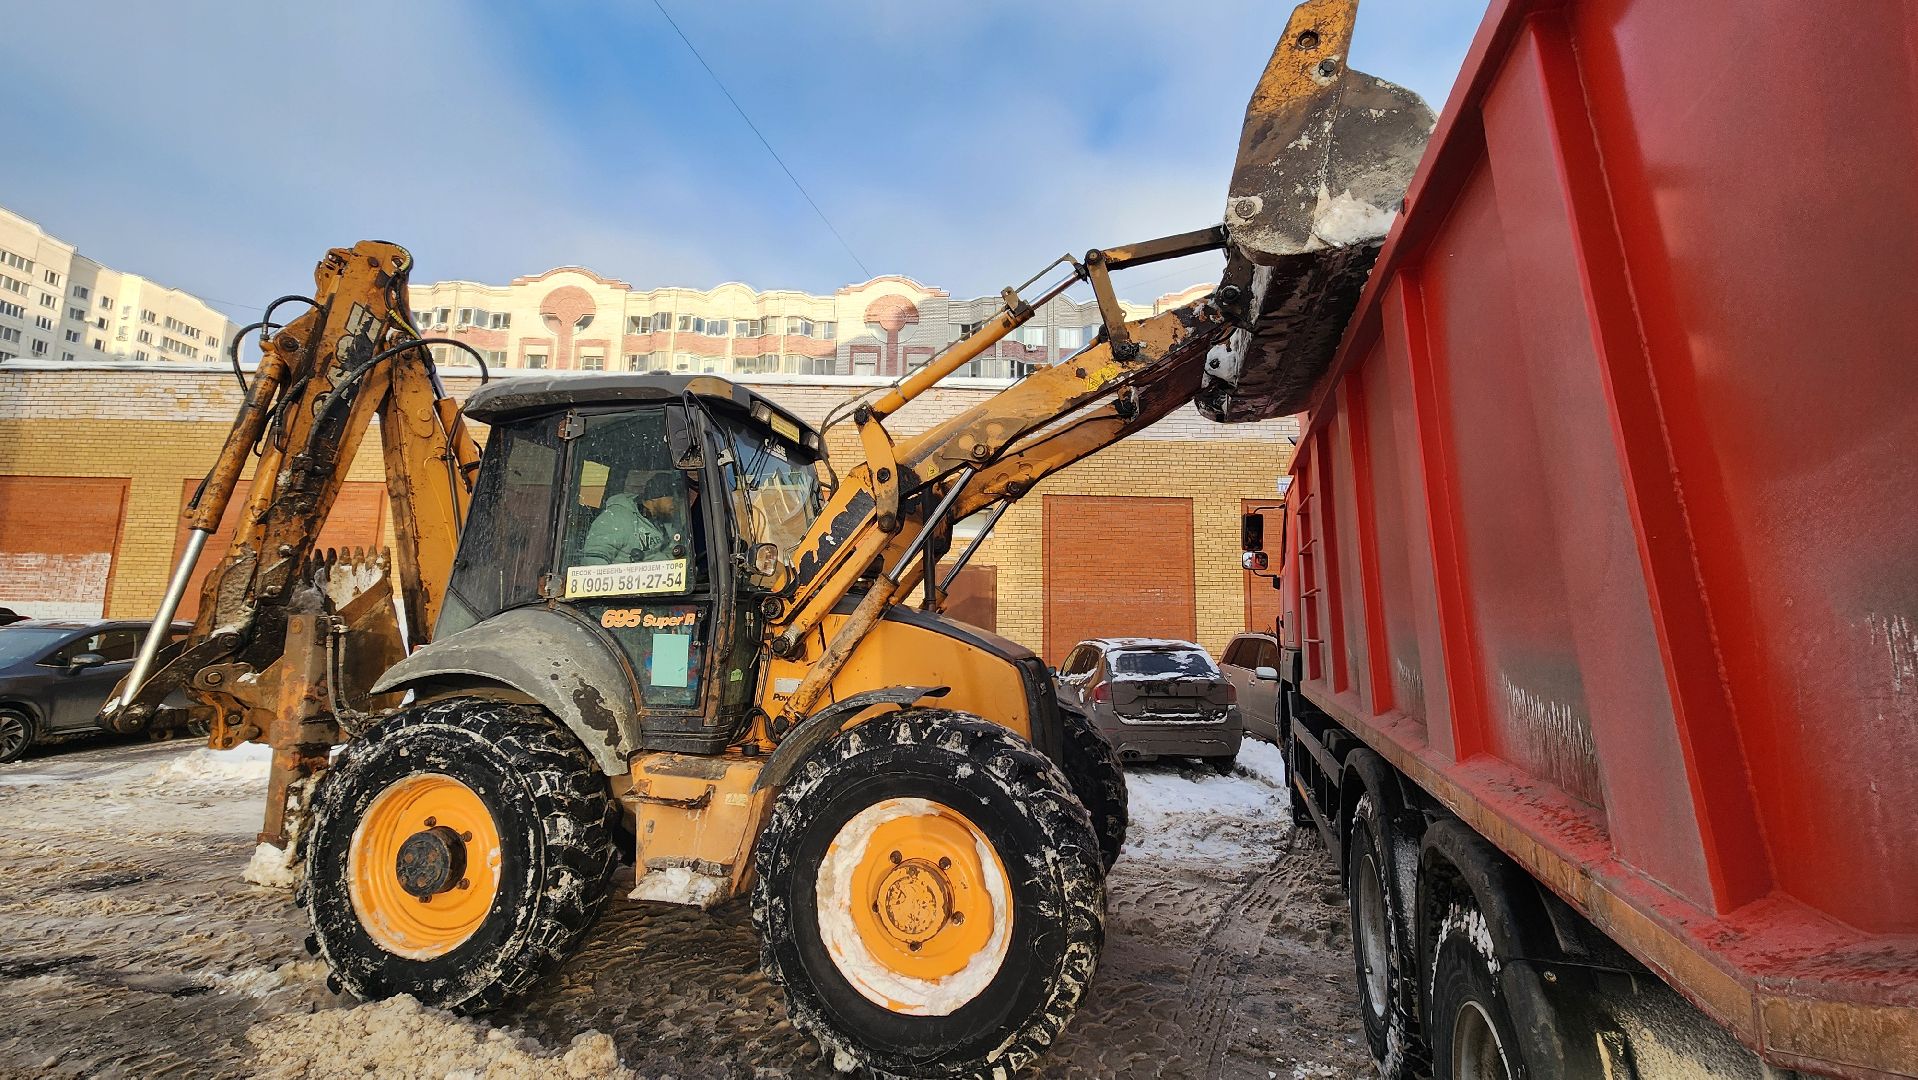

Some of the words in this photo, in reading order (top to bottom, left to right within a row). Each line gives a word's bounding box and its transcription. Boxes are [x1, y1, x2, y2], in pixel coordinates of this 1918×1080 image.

[571, 569, 592, 577] ПЕСОК
[596, 567, 623, 576] ЩЕБЕНЬ
[627, 564, 661, 573] ЧЕРНОЗЕМ
[666, 562, 684, 570] ТОРФ
[571, 579, 578, 594] 8
[582, 576, 614, 593] (905)
[618, 571, 682, 591] 581-27-54
[601, 608, 642, 628] 695
[643, 613, 685, 630] Super
[773, 693, 792, 702] Pow
